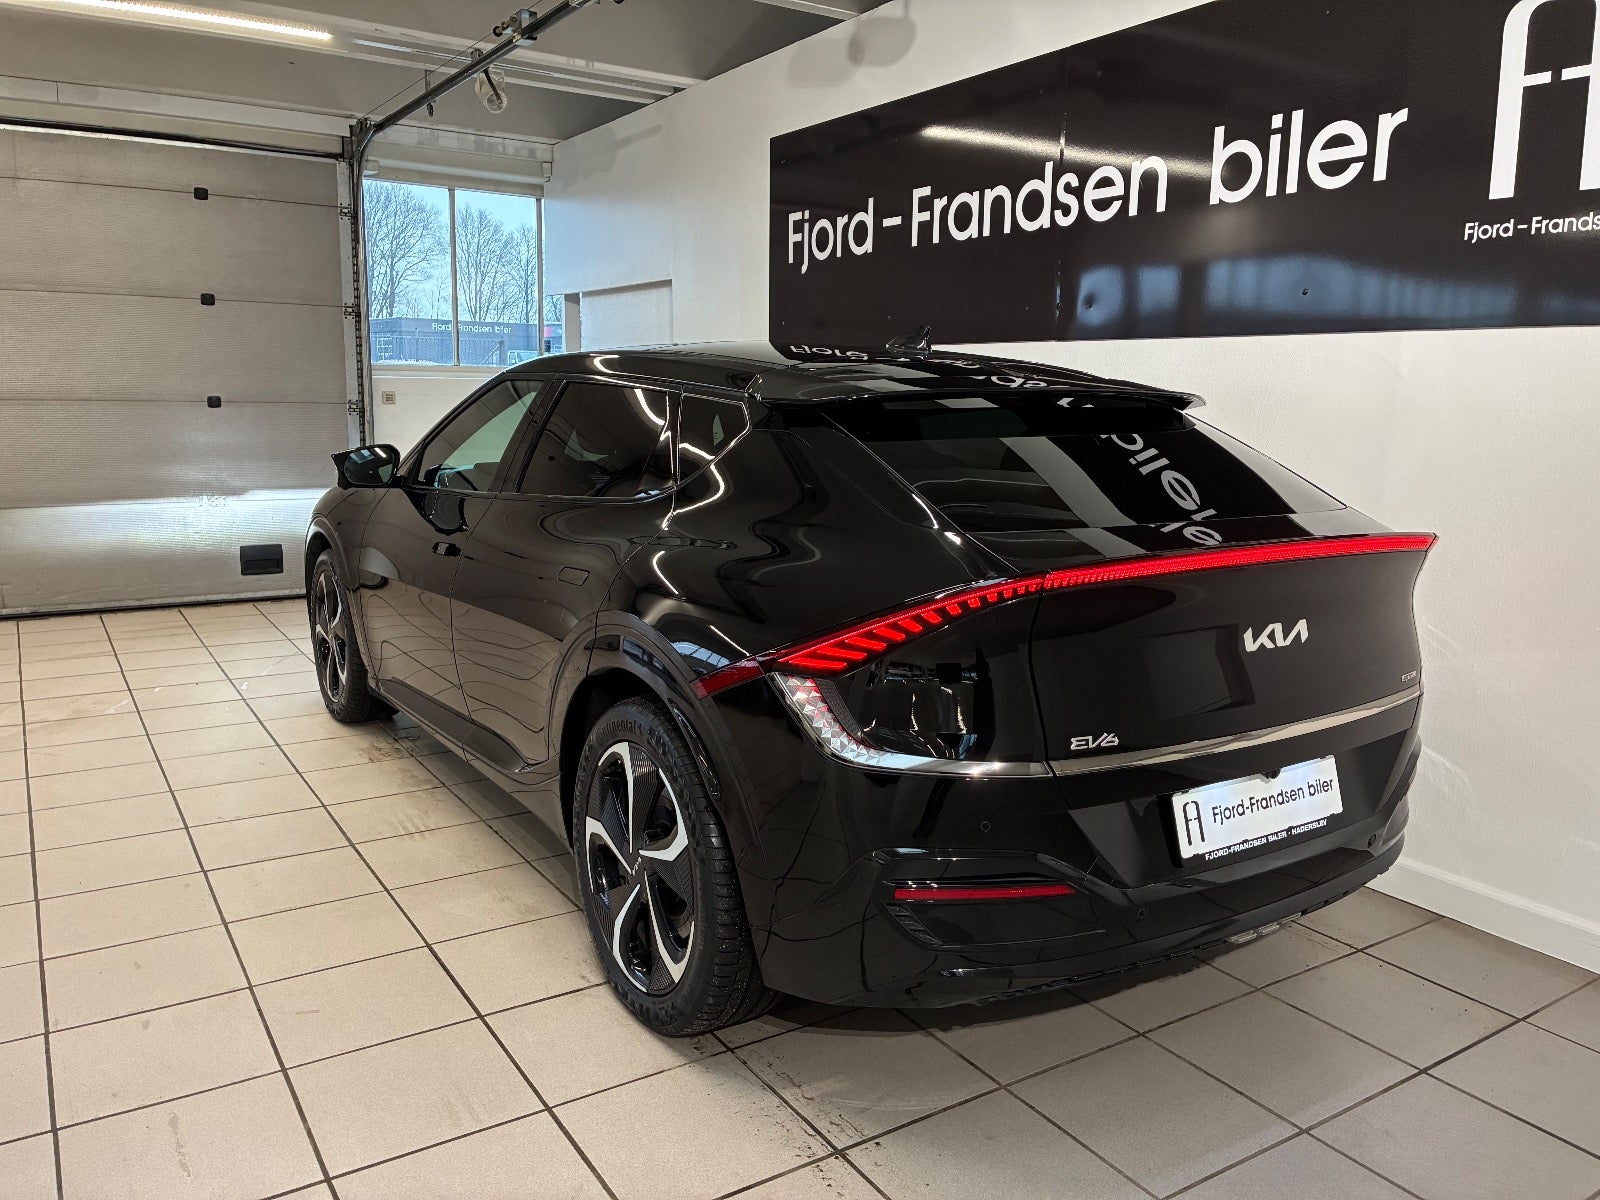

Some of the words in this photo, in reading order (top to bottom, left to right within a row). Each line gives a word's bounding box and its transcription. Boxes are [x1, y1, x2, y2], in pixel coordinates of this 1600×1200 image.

[1209, 107, 1409, 205] biler
[1244, 618, 1309, 652] KIA
[1070, 732, 1119, 750] EV6
[1211, 786, 1305, 826] Fjord-Frandsen
[1307, 778, 1334, 797] biler
[1205, 836, 1267, 861] FJORD-FRANDSEN
[1268, 831, 1288, 843] BILER
[1291, 818, 1328, 835] HADERSLEV
